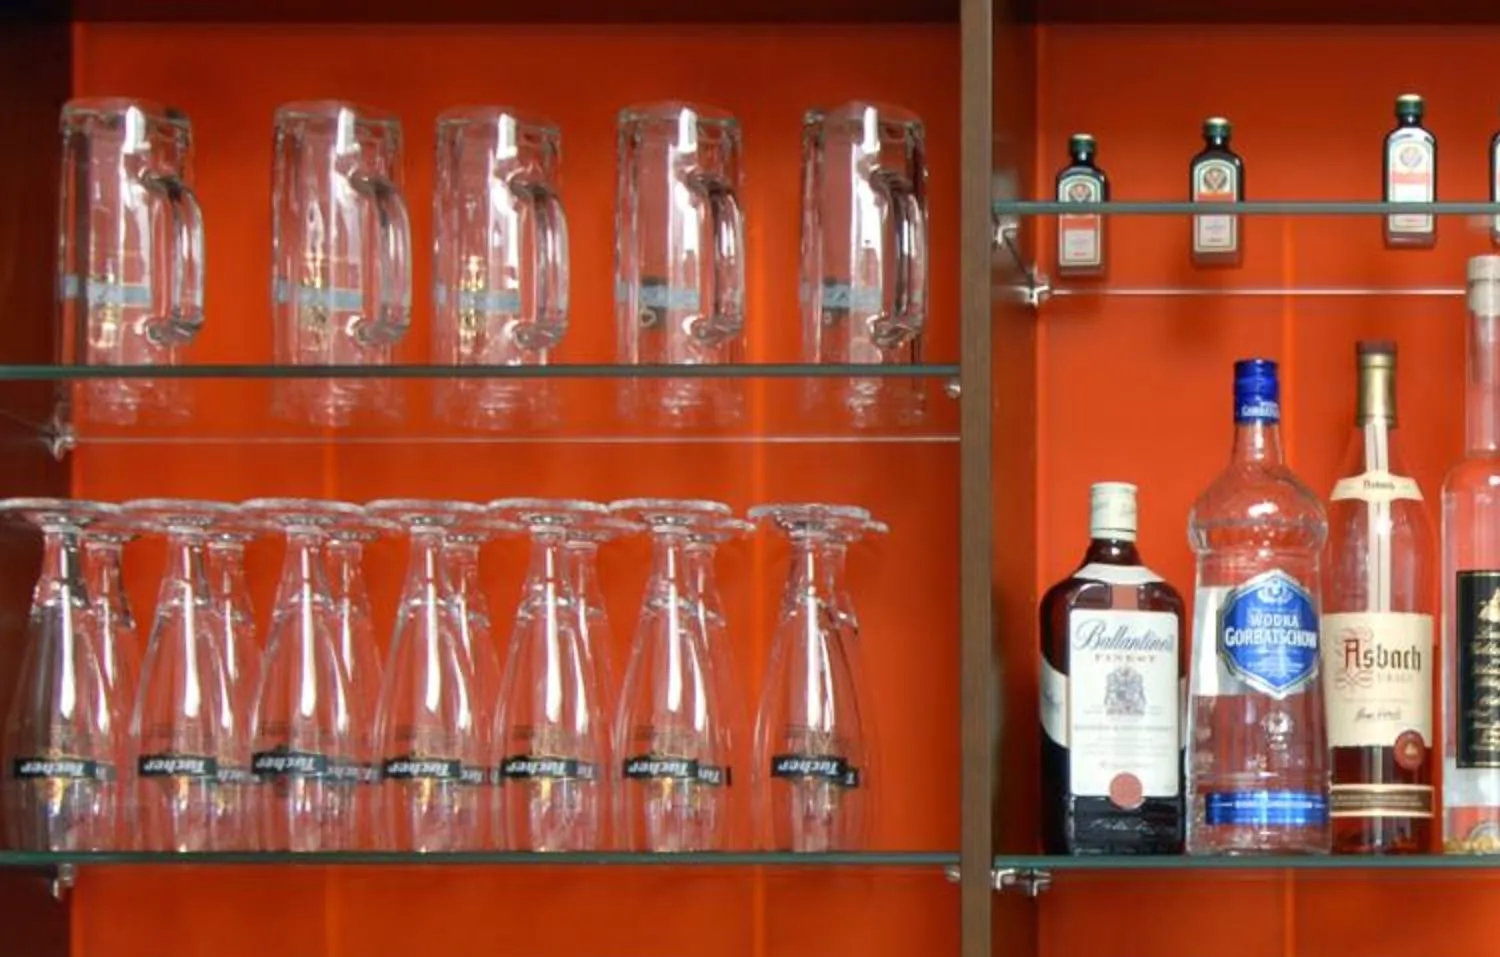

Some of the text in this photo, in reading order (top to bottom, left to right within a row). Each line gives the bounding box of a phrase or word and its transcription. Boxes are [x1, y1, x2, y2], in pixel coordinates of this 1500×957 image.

[1250, 611, 1300, 627] WODKA
[1225, 626, 1317, 648] GORBATSCHOW
[1343, 638, 1422, 671] Asbach
[20, 762, 86, 778] Tucher
[144, 757, 206, 774] Tucher
[256, 755, 317, 772] Tucher
[387, 758, 452, 777] Tucher
[506, 759, 567, 775] Tucher
[628, 759, 690, 775] Tucher
[777, 757, 842, 775] Tucher
